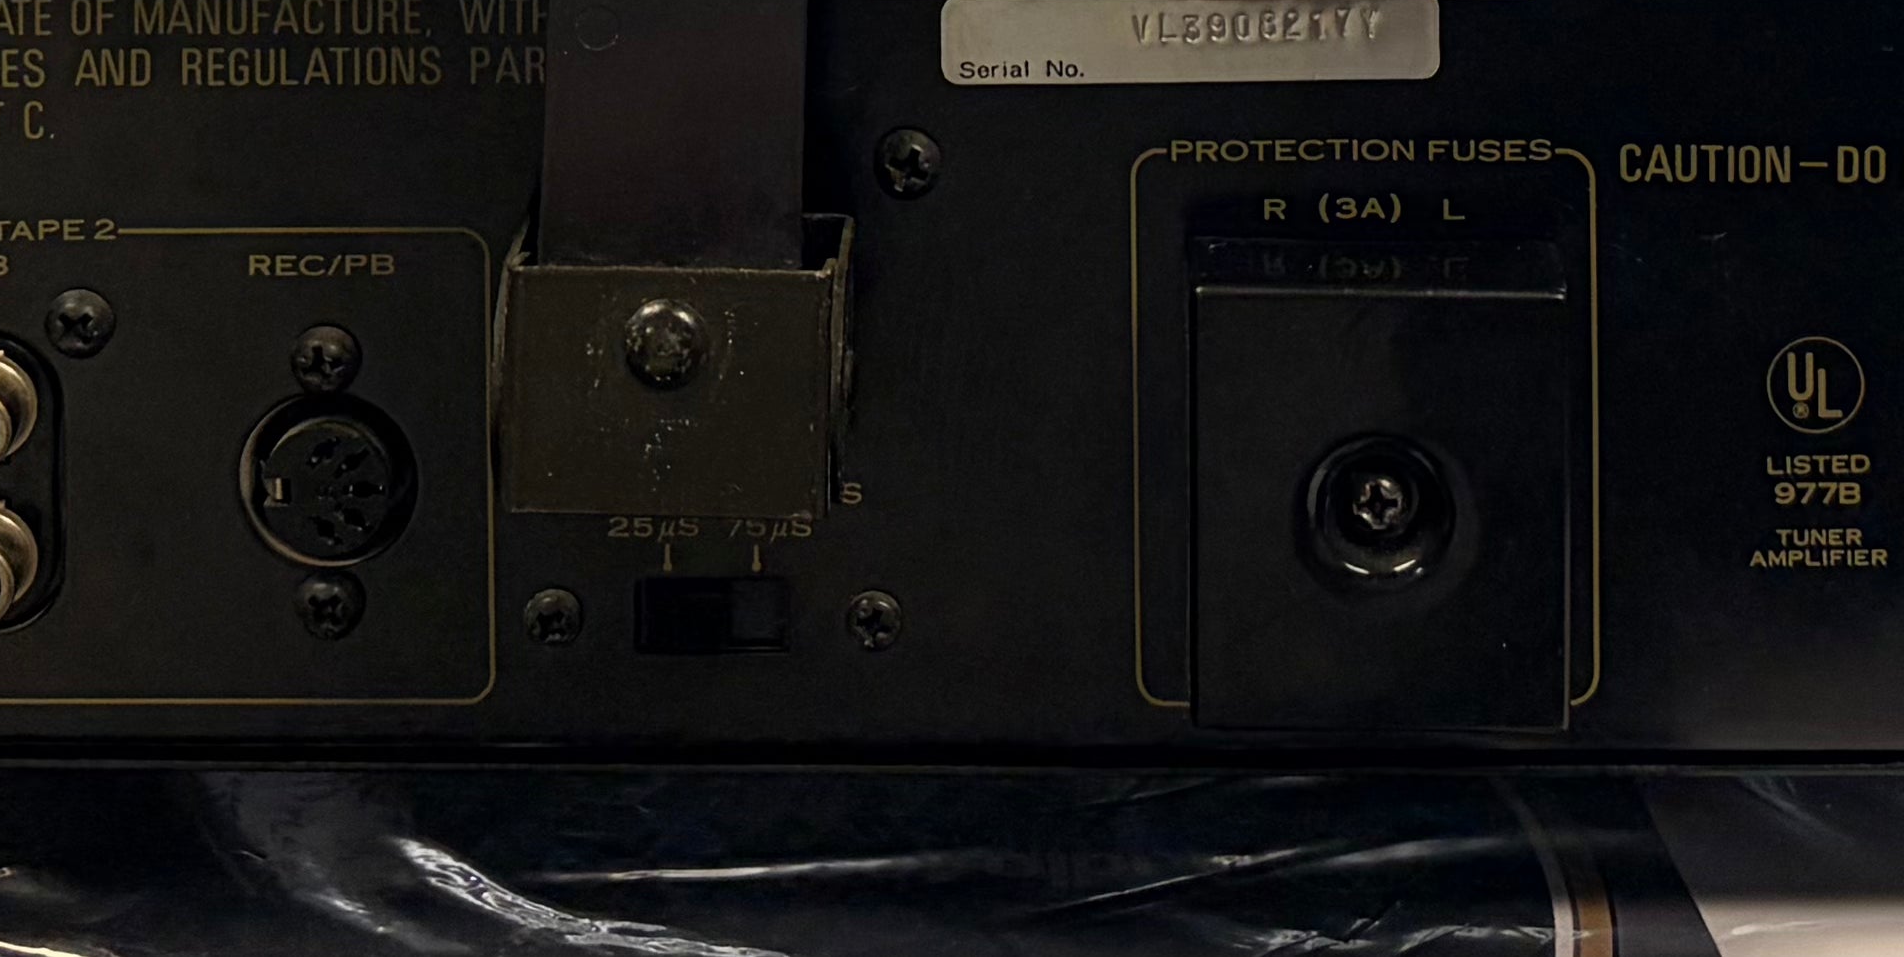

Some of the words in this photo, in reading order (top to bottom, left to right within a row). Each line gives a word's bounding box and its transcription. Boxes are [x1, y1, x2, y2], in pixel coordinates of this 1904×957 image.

[74, 48, 152, 87] AND
[181, 46, 441, 87] REGULATIONS
[959, 61, 1030, 78] Serial
[1045, 61, 1085, 78] No.
[23, 100, 55, 140] C.
[1170, 138, 1415, 163] PROTECTION
[1427, 138, 1553, 163] FUSES
[1263, 198, 1287, 221] R
[1318, 192, 1402, 224] (3A)
[1442, 198, 1466, 221] L
[93, 218, 117, 241] 2
[248, 253, 395, 277] REC/PB
[1786, 351, 1844, 419] UL
[1766, 453, 1871, 476] LISTED
[1774, 481, 1862, 505] 977B
[1776, 528, 1863, 547] TUNER
[1749, 548, 1888, 568] AMPLIFIER
